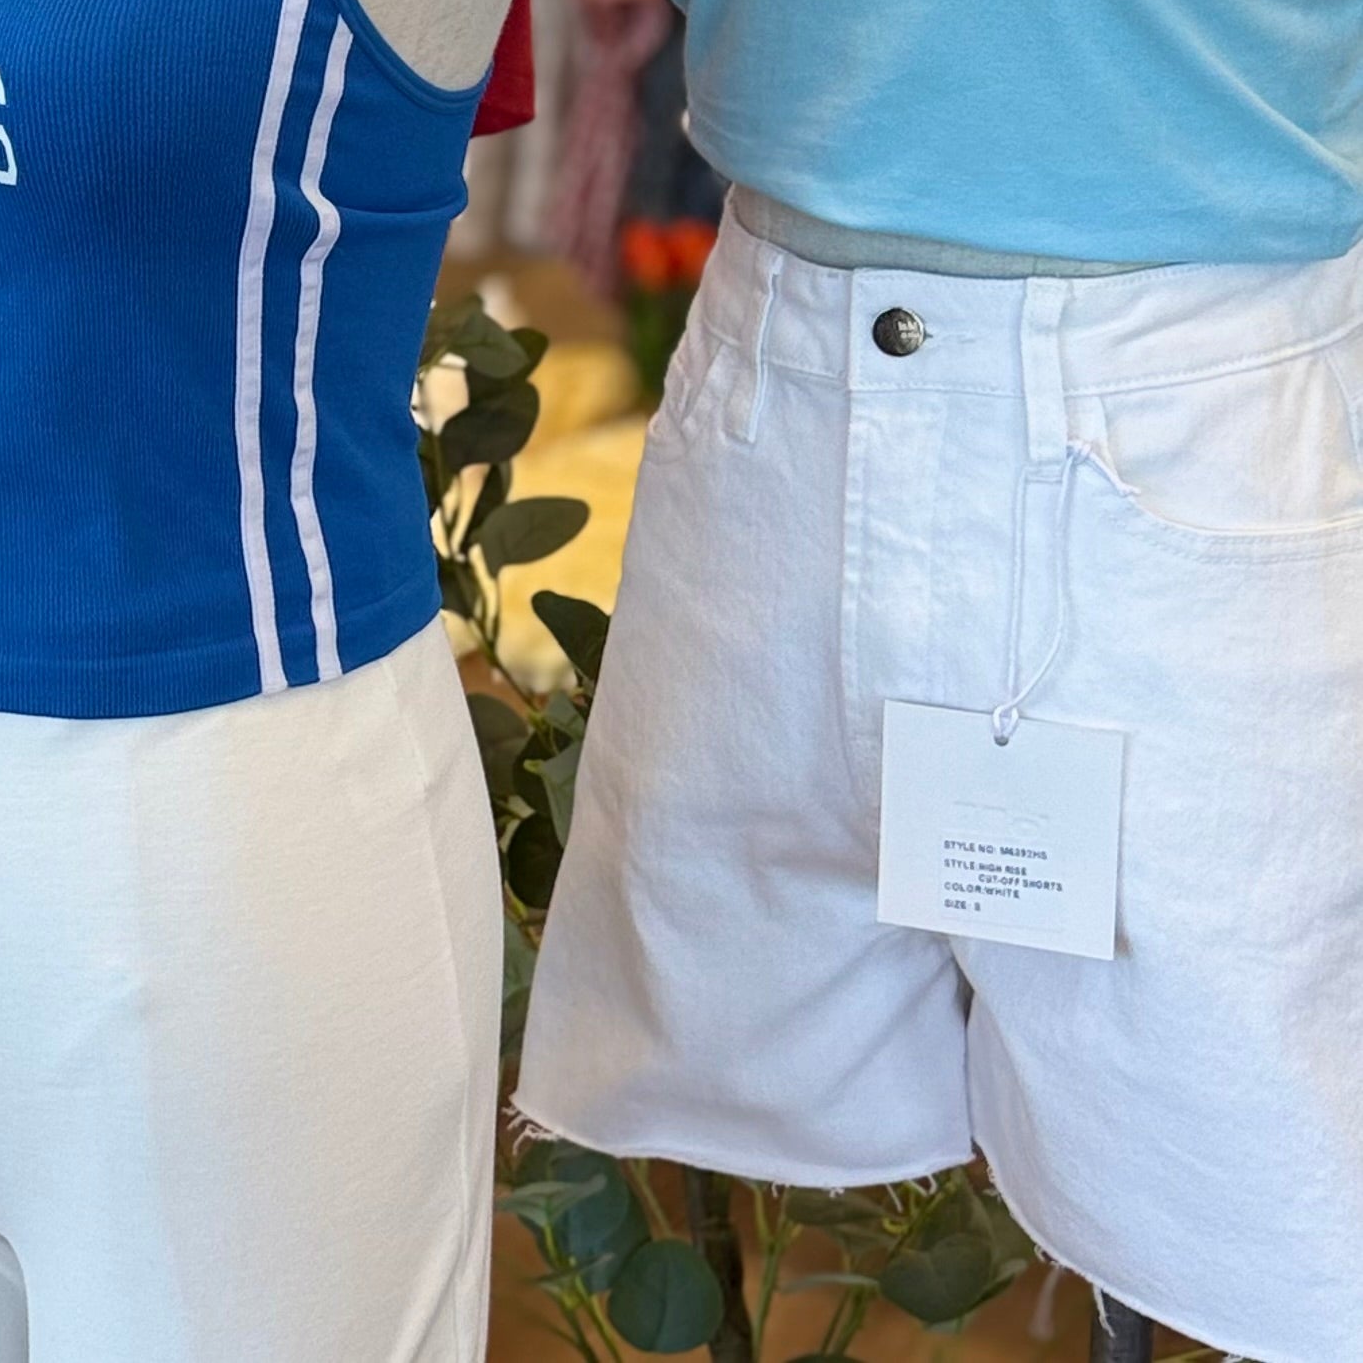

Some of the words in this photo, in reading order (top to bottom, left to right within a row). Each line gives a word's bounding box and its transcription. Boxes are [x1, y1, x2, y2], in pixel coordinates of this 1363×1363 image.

[943, 840, 975, 852] STYLE
[1004, 865, 1027, 876] RISE
[978, 873, 1020, 886] CUT-OFF
[1022, 879, 1063, 892] SHORTS
